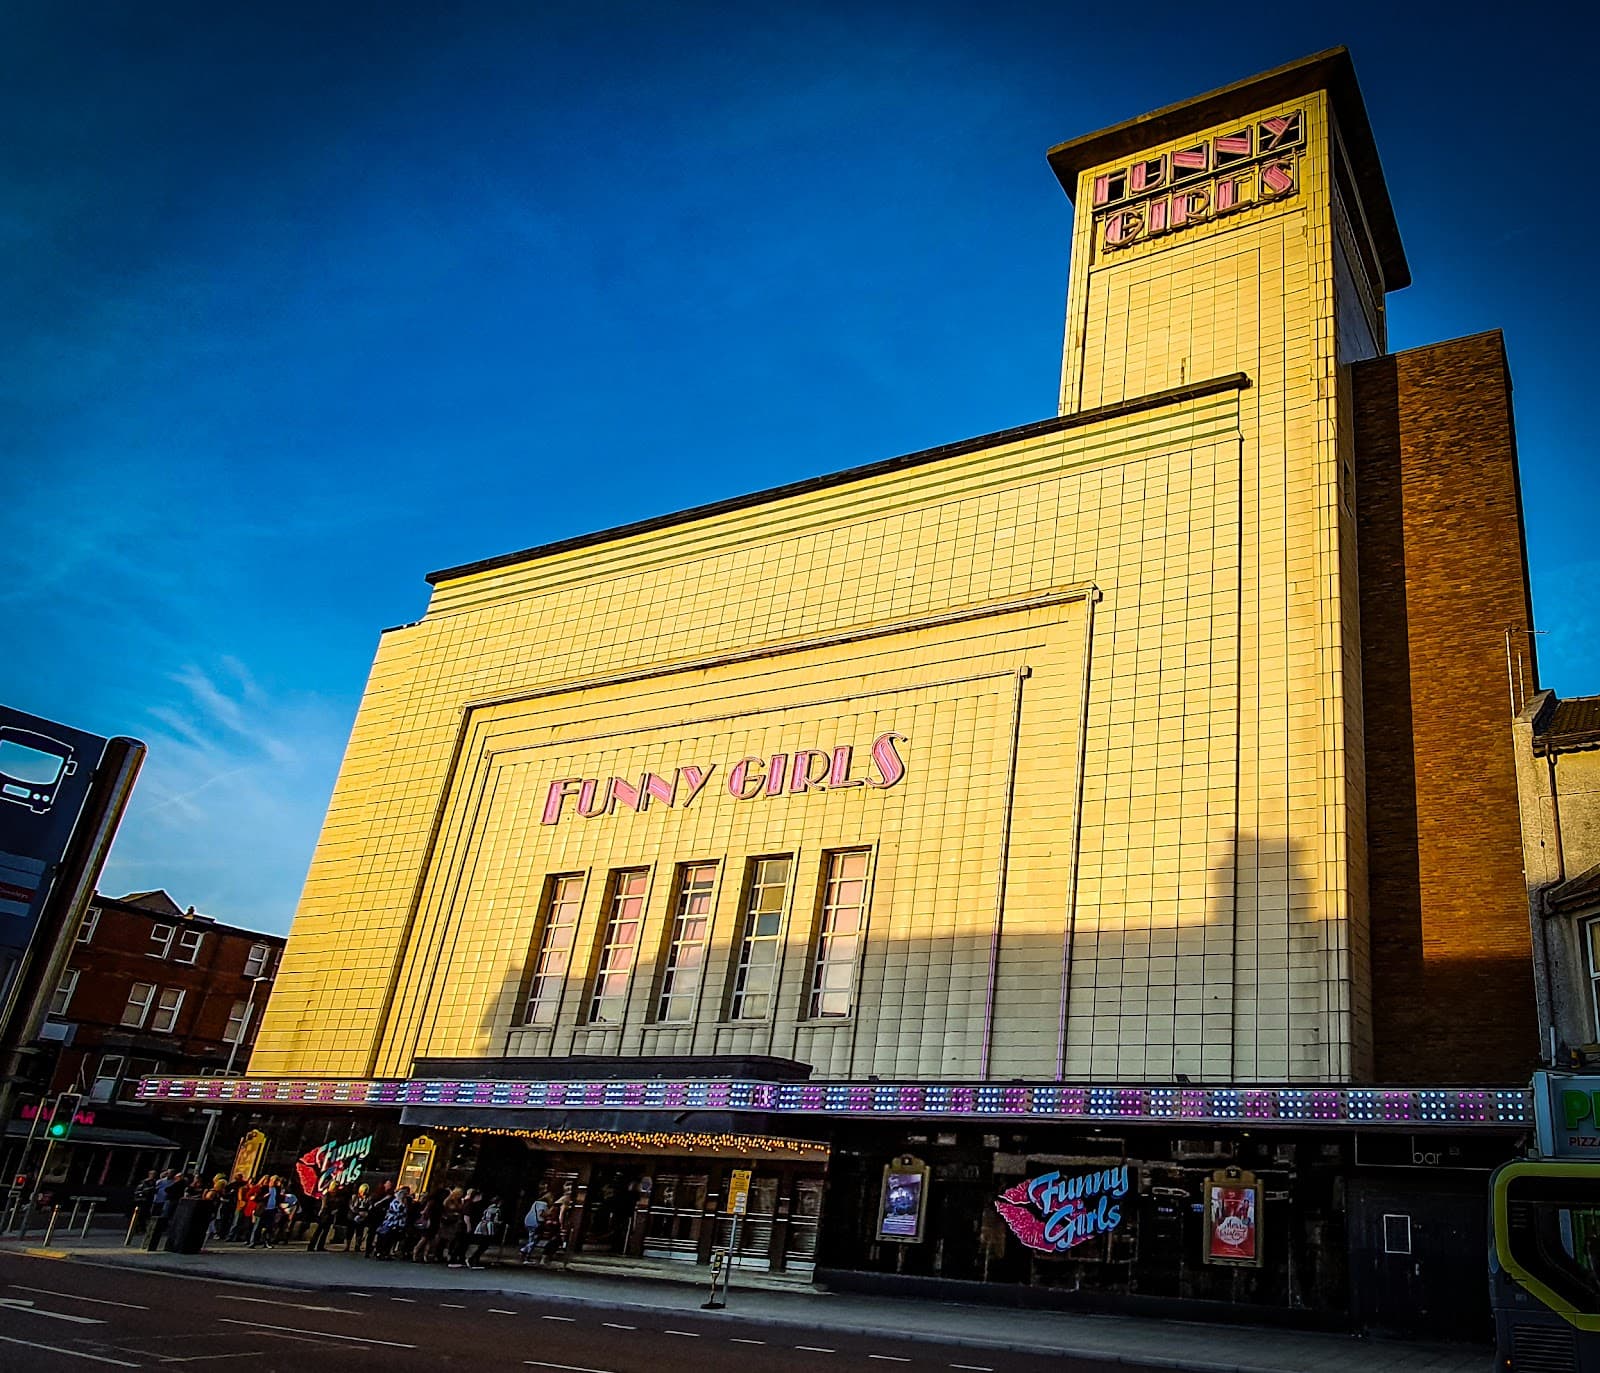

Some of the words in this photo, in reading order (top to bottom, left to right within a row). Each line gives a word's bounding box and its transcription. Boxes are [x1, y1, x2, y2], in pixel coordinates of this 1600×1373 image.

[1094, 108, 1304, 207] FUNNY
[1104, 157, 1294, 247] GIRLS
[540, 763, 716, 825] FUNNY
[727, 732, 908, 799] GIRLS
[316, 1135, 373, 1172] Funny
[1411, 1136, 1443, 1166] bar
[1027, 1164, 1129, 1216] Funny
[1044, 1195, 1122, 1249] Girls
